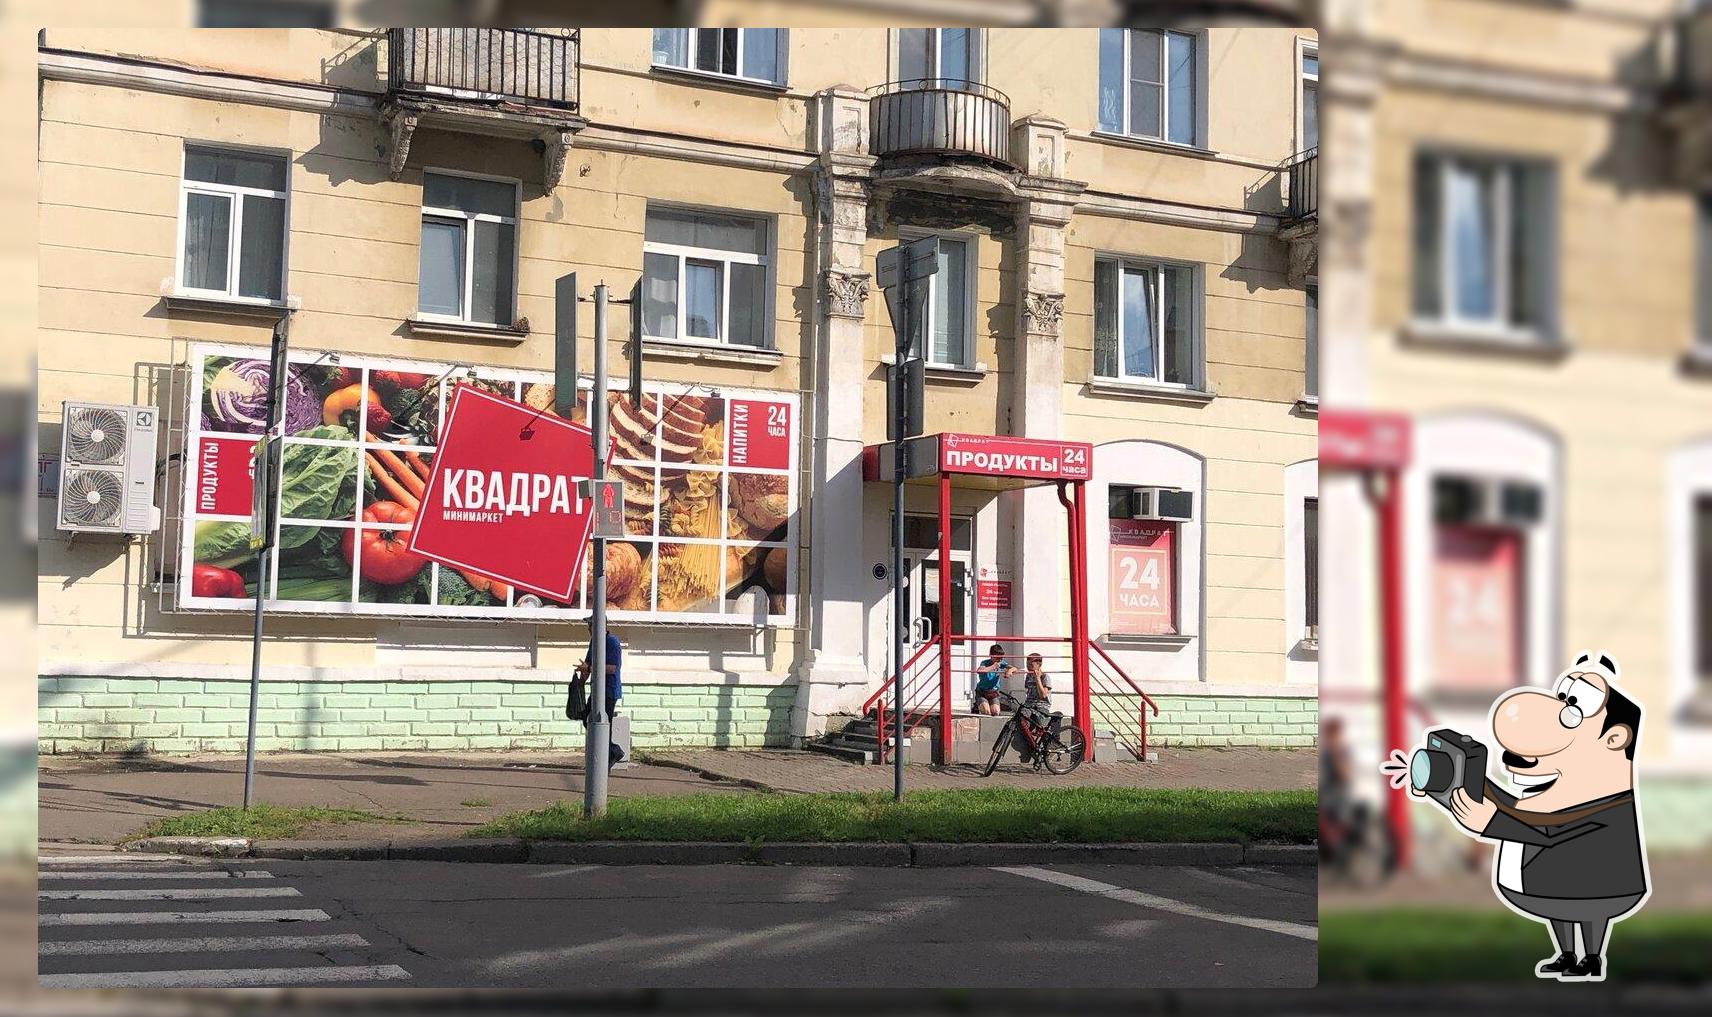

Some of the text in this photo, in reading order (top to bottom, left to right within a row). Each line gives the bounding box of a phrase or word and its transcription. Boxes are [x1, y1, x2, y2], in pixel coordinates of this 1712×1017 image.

[768, 405, 787, 426] 24
[732, 404, 749, 464] НАПИТКИ
[767, 427, 787, 437] ЧАСА
[946, 450, 1058, 472] ПРОДУКТЫ
[1064, 449, 1086, 464] 24
[201, 442, 219, 510] ПРОДУКТЫ
[1062, 465, 1087, 474] часа
[443, 468, 590, 517] КВАДРАТ
[443, 510, 504, 523] МИНИМАРКЕТ
[1119, 556, 1160, 590] 24
[1119, 593, 1160, 608] ЧАСА
